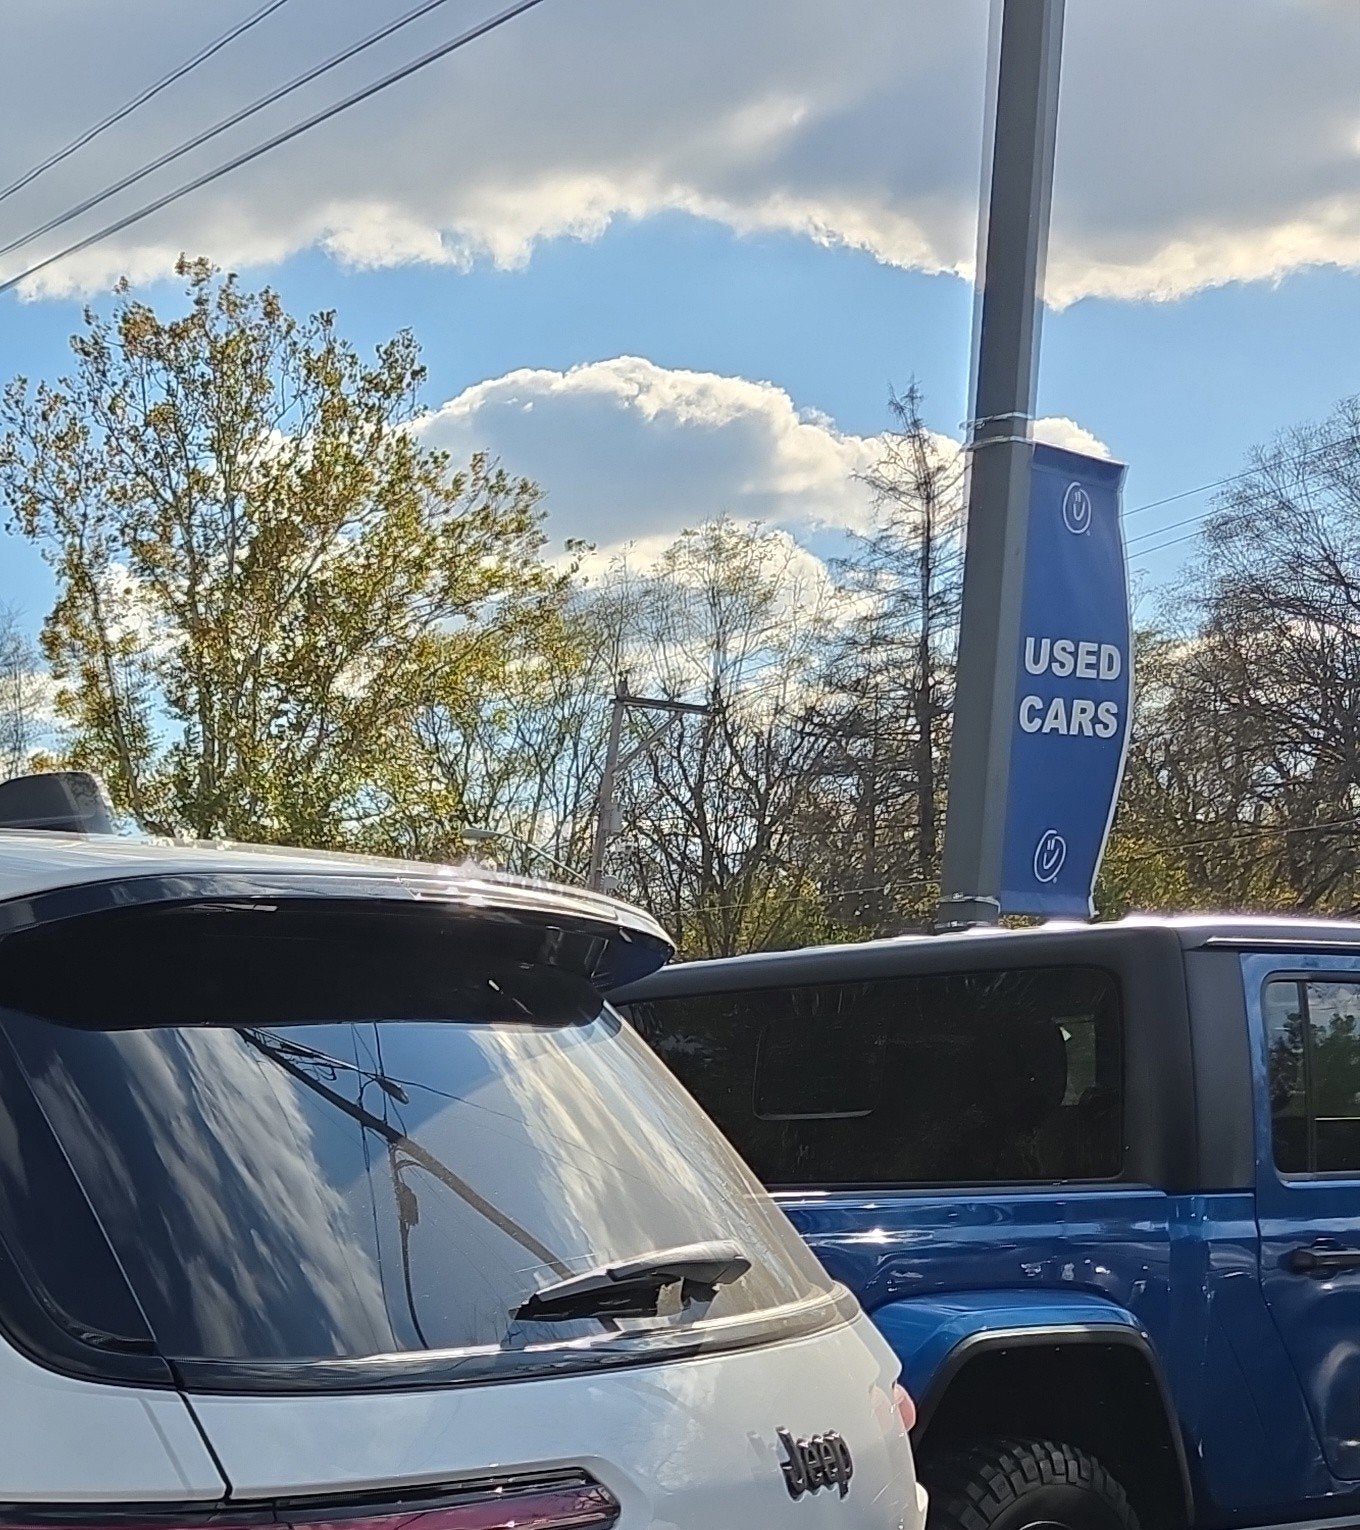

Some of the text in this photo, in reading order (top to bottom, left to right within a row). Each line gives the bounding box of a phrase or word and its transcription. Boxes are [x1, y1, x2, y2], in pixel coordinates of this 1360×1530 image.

[1024, 636, 1122, 681] USED
[1019, 694, 1119, 739] CARS
[776, 1426, 854, 1501] Jeep
